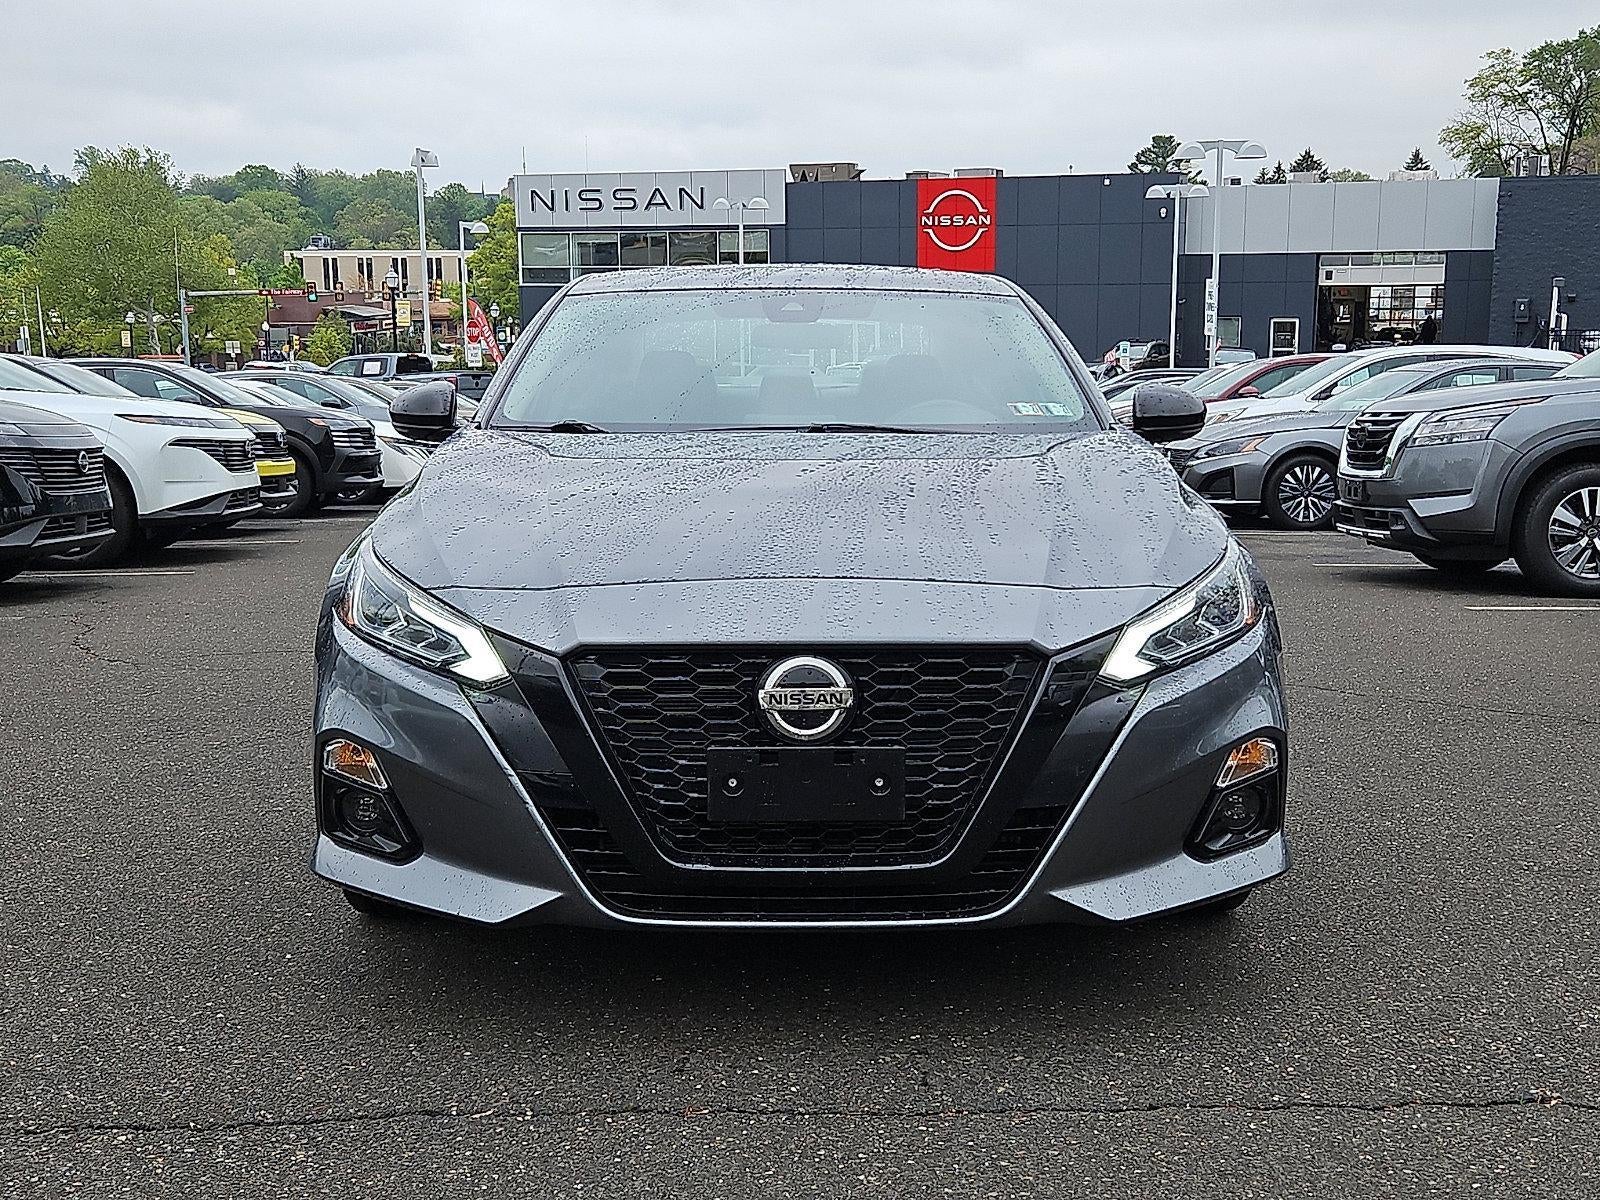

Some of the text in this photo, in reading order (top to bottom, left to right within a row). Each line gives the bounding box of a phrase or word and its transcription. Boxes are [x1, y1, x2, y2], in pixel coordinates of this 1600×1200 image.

[530, 186, 706, 212] NISSAN
[921, 214, 991, 226] NISSAN
[467, 327, 480, 337] STOP
[768, 693, 844, 706] NISSAN
